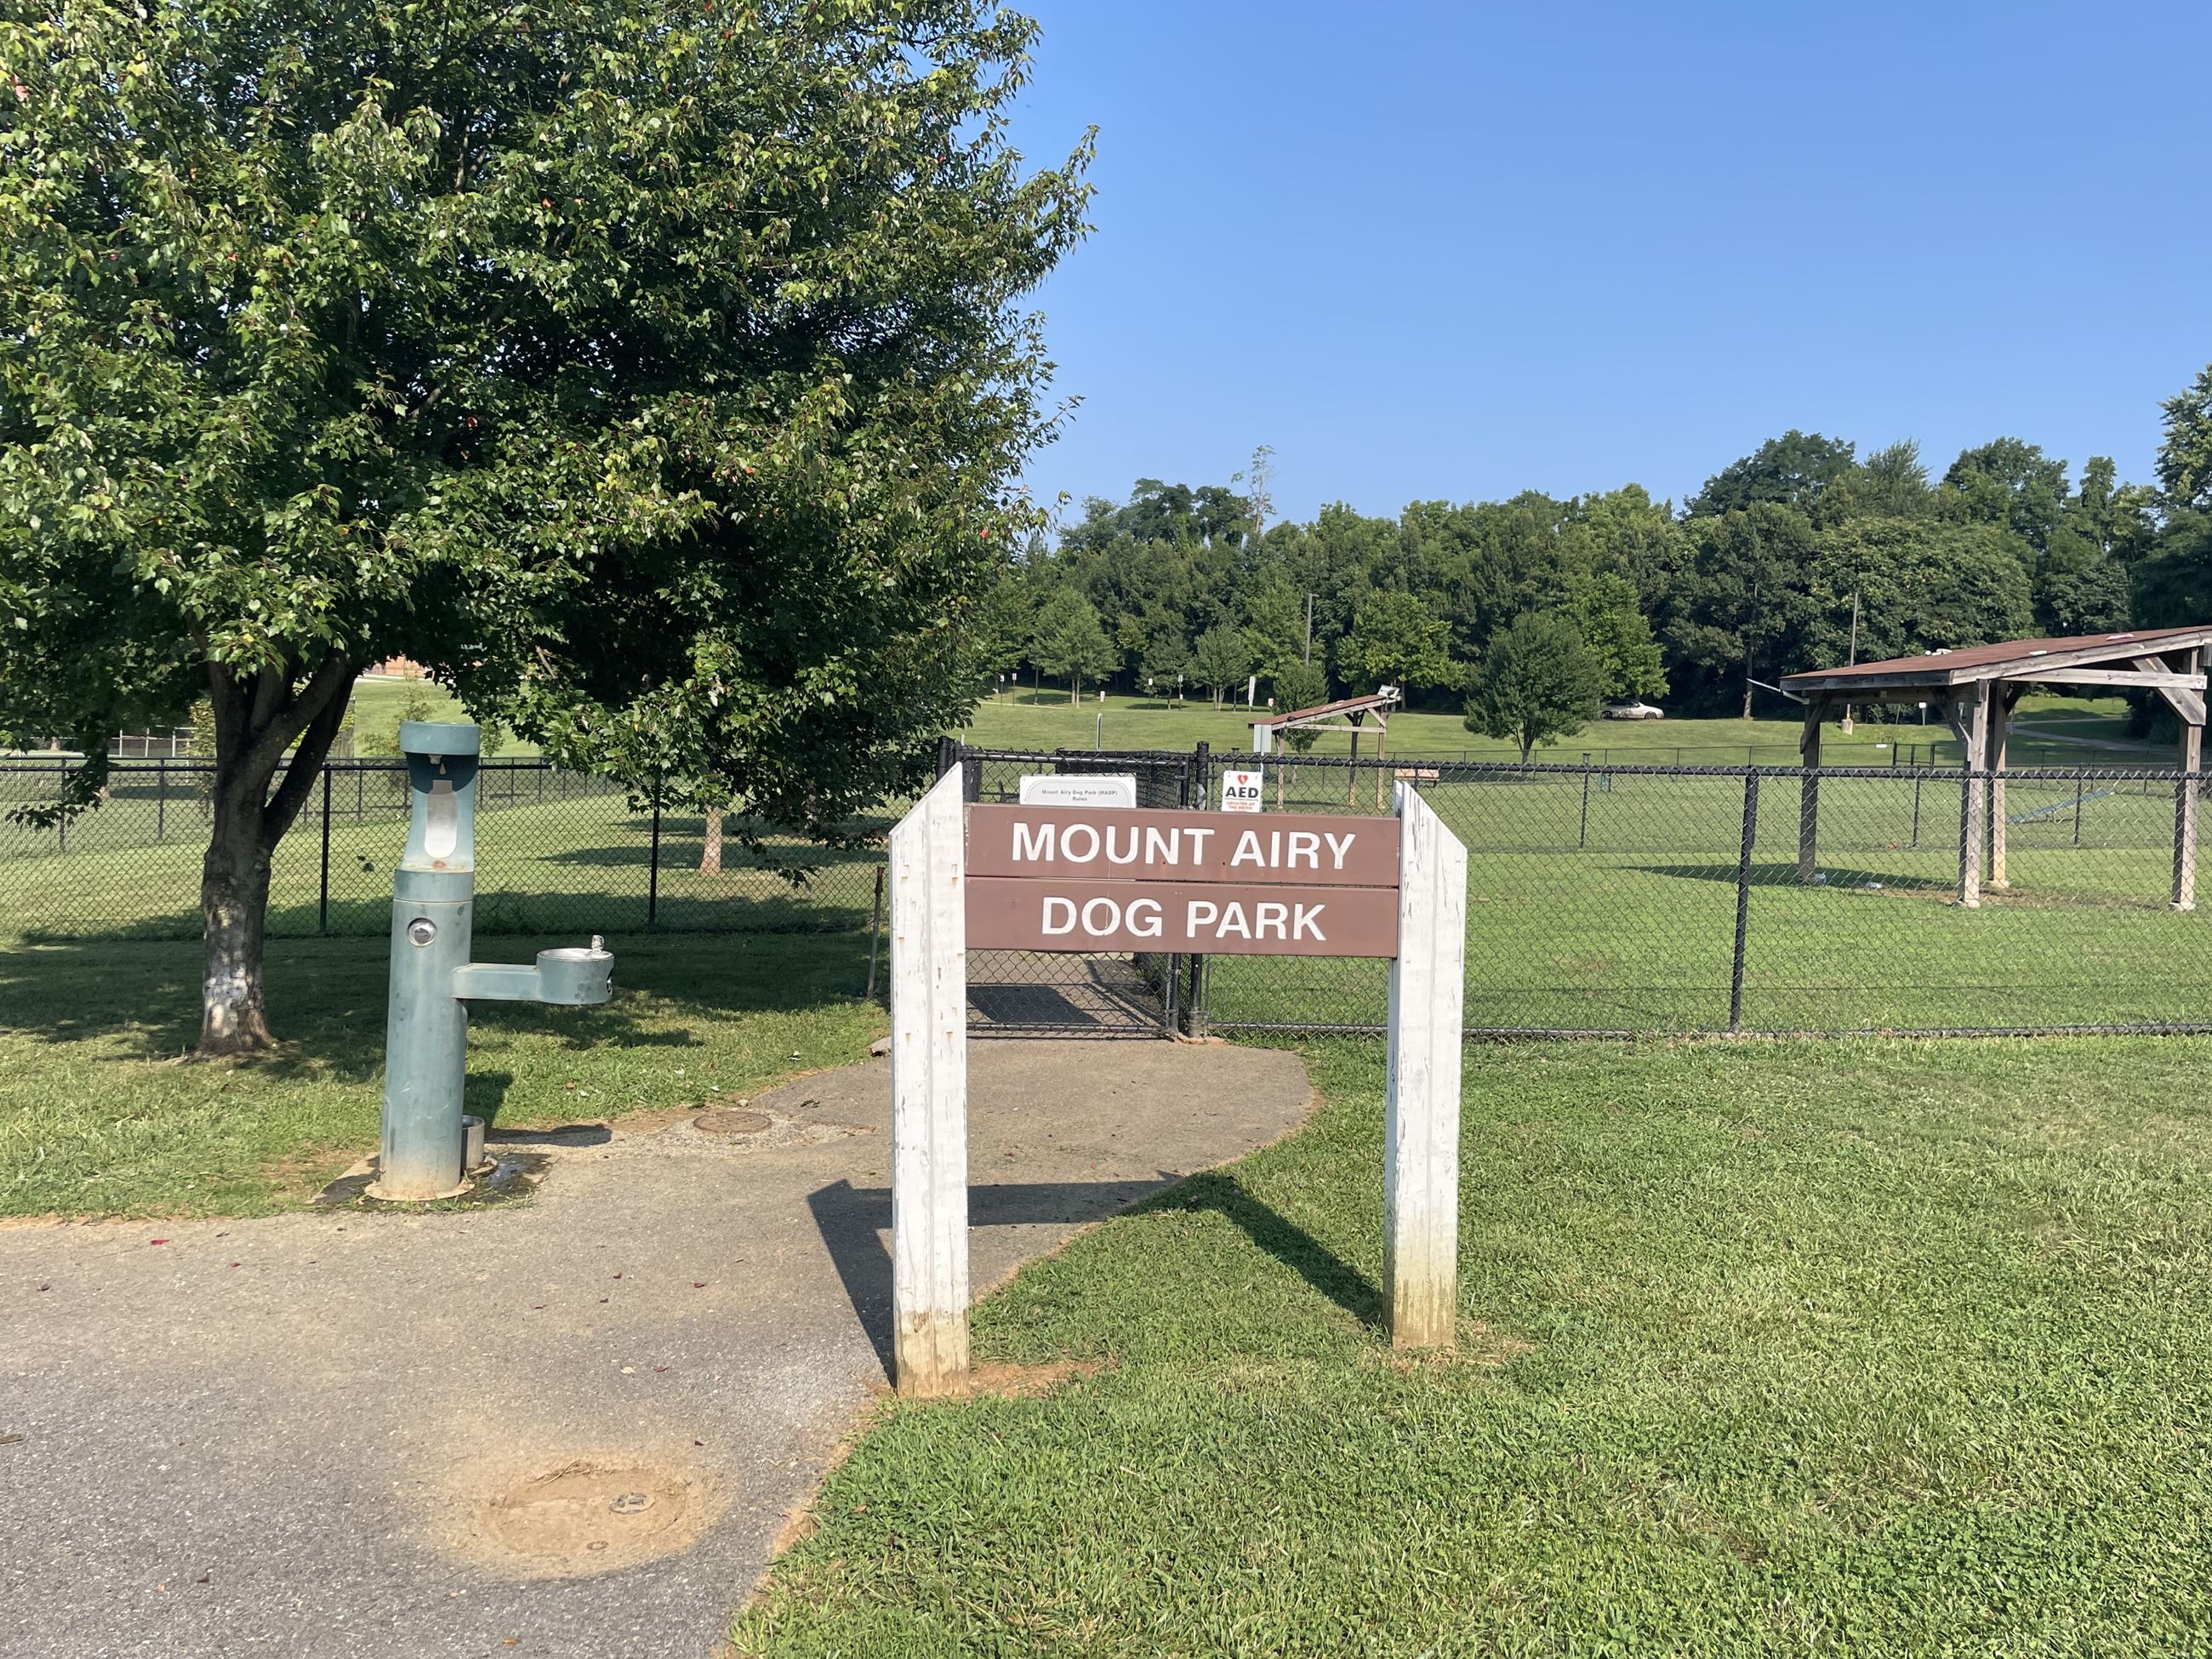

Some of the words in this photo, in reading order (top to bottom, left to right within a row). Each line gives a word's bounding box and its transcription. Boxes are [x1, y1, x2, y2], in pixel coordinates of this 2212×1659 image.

[1225, 786, 1258, 798] AED
[1012, 822, 1215, 865] MOUNT
[1230, 830, 1357, 870] AIRY
[1041, 896, 1163, 938] DOG
[1186, 900, 1327, 942] PARK
